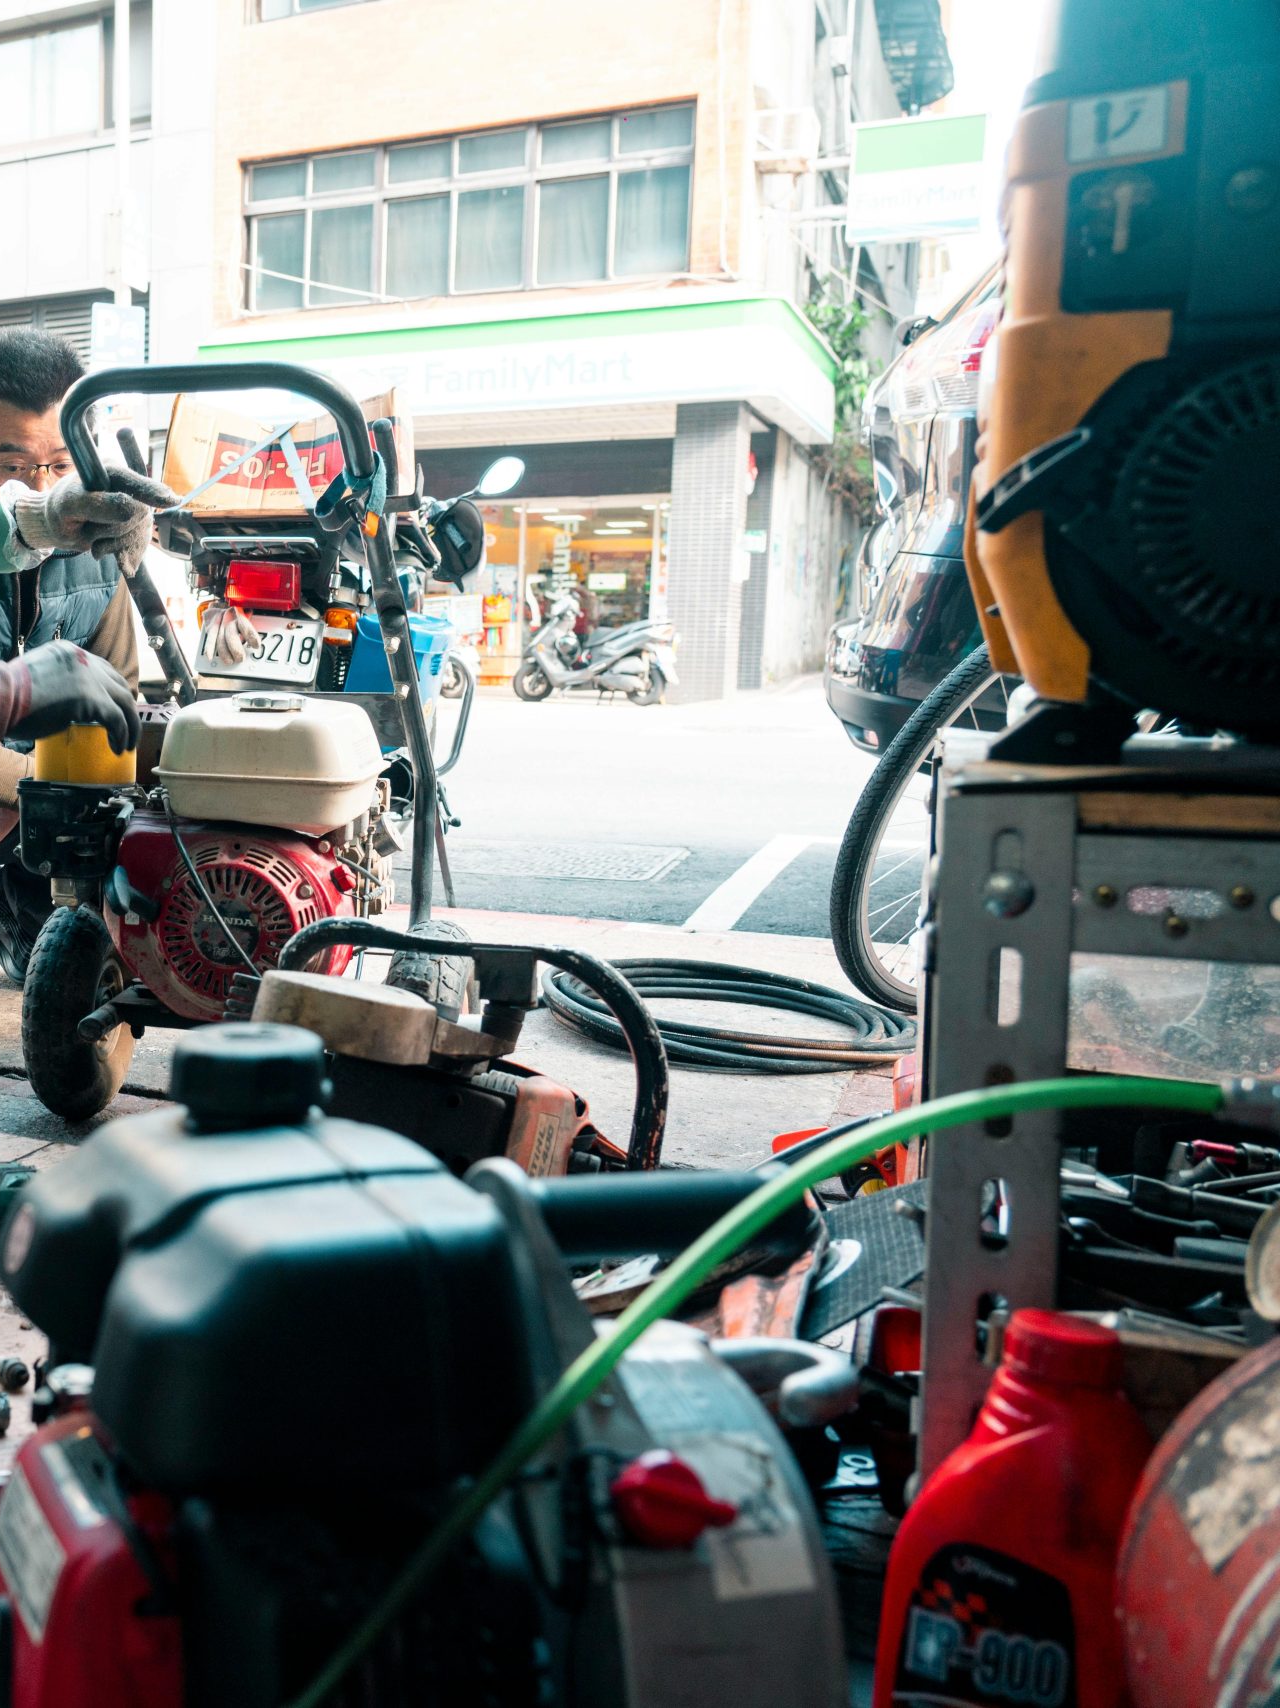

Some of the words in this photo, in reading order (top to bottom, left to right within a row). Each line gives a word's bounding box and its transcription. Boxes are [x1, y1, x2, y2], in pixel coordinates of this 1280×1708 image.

[855, 184, 977, 210] FamilyMart
[424, 351, 632, 395] FamilyMart
[203, 914, 255, 927] HNDA
